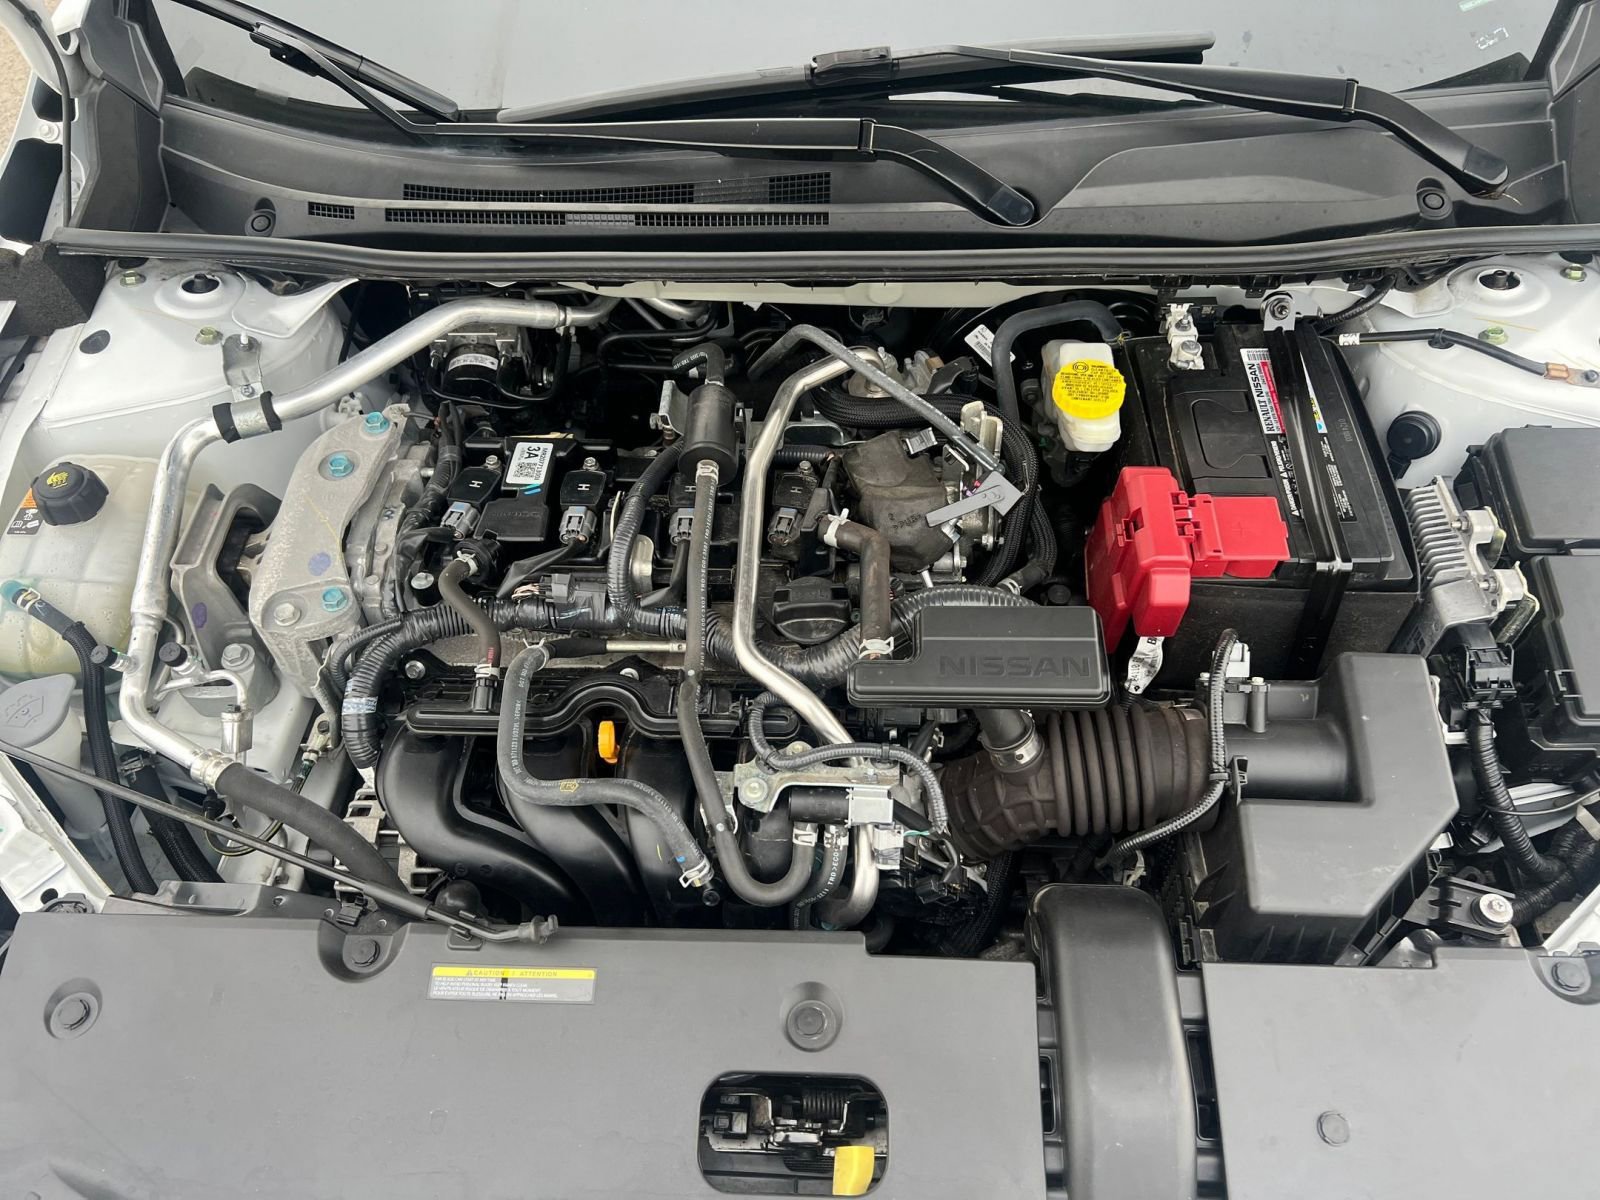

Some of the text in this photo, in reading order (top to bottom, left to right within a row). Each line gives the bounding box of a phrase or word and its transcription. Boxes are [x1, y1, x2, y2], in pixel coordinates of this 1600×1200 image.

[1249, 363, 1263, 397] NISSAN
[1259, 399, 1275, 432] RENAULT
[524, 446, 541, 459] 3A
[577, 483, 591, 491] H
[938, 654, 1091, 678] NISSAN
